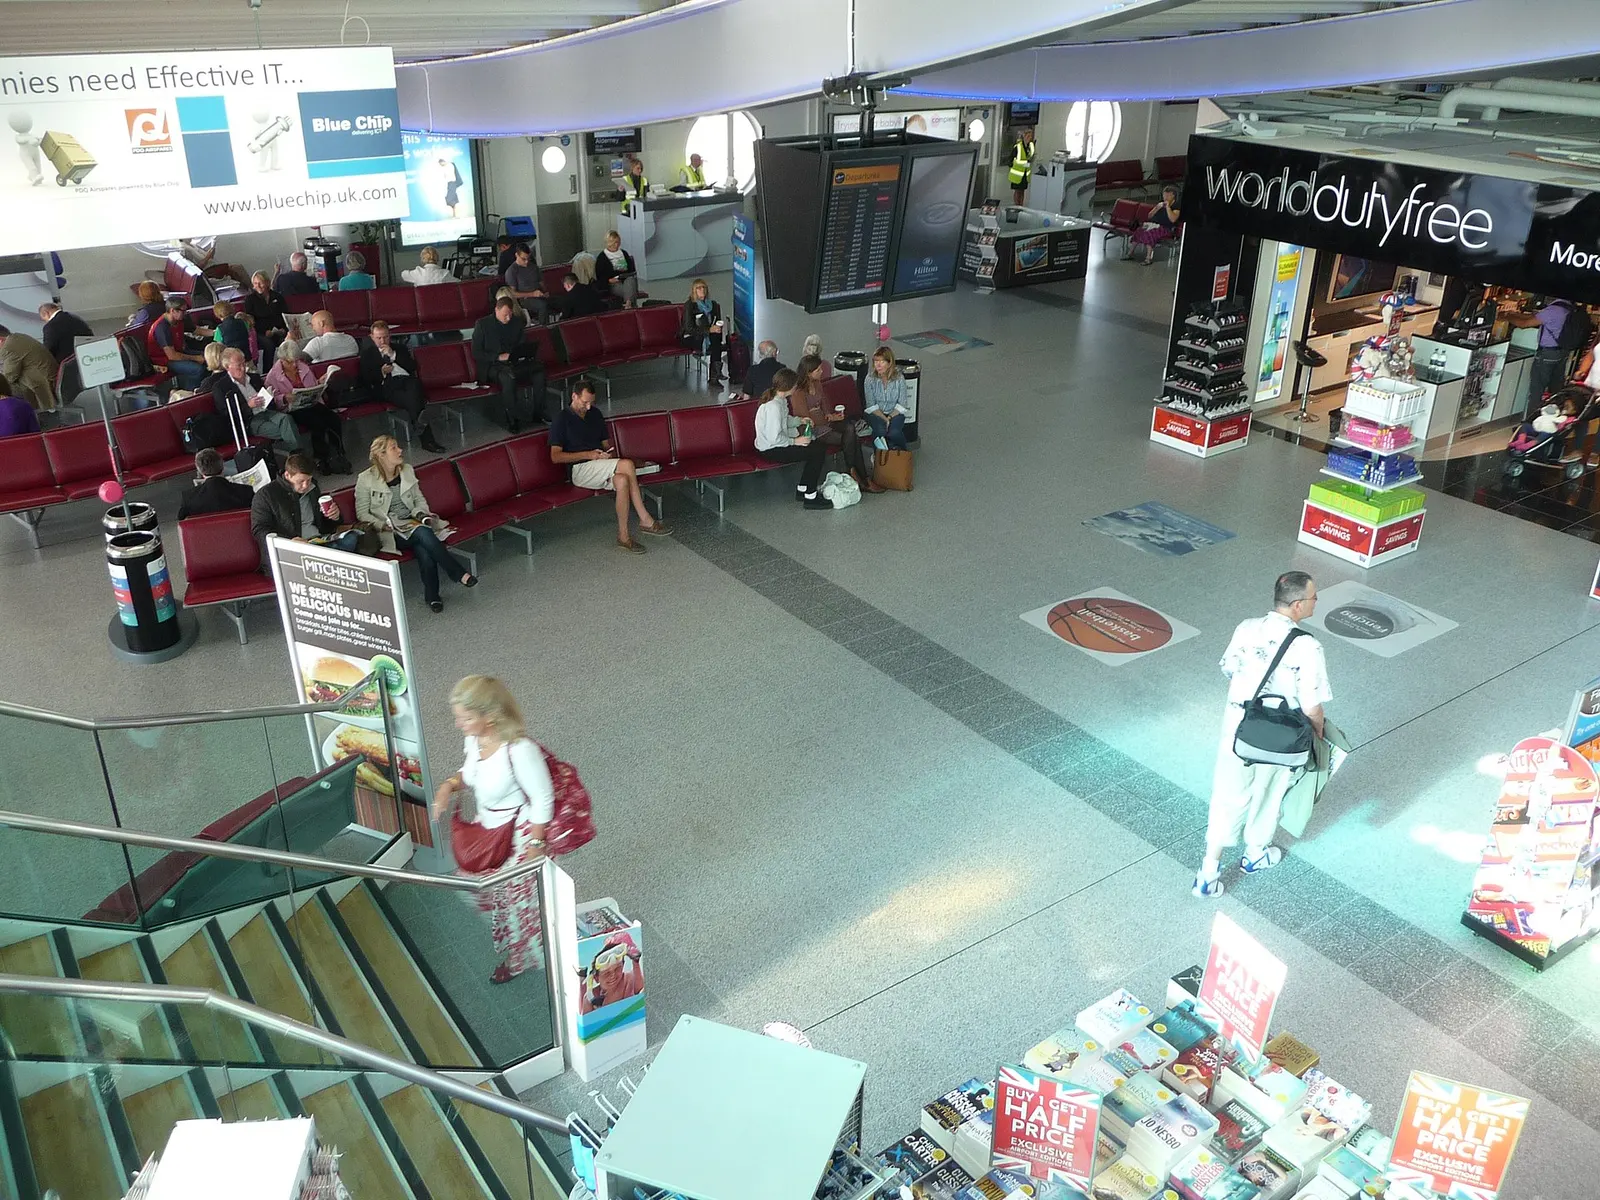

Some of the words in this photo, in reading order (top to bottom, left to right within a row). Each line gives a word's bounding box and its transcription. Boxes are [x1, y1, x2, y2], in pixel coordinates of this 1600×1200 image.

[1, 71, 60, 95] nies
[68, 67, 137, 92] need
[146, 64, 254, 89] Effective
[263, 63, 304, 85] IT...
[312, 117, 351, 132] Blue
[355, 115, 392, 131] Chip
[203, 185, 397, 215] www.bluechip.uk.com
[1206, 164, 1493, 248] worlddutyfree
[914, 265, 938, 275] Hilton
[1166, 423, 1191, 436] SAVINGS
[1320, 524, 1351, 541] SAVINGS
[1385, 531, 1408, 545] SAVINGS
[305, 560, 364, 583] MITCHELL'S
[289, 582, 308, 595] WE
[308, 586, 343, 604] SERVE
[292, 594, 351, 618] DELICIOUS
[353, 608, 391, 628] MEALS
[1076, 608, 1141, 641] basketball
[1340, 609, 1389, 634] Fencing
[1216, 971, 1261, 1019] PRICE
[944, 1092, 974, 1121] BENNET
[951, 1089, 981, 1117] MICHAE
[1005, 1097, 1086, 1134] HALF
[1006, 1086, 1034, 1102] BUY
[1039, 1096, 1044, 1105] 1
[1049, 1099, 1077, 1114] GET
[1081, 1108, 1087, 1118] 1
[1418, 1096, 1451, 1114] BUY
[1466, 1110, 1500, 1126] GET
[1141, 1116, 1152, 1128] JO
[1228, 1101, 1262, 1132] Montanari
[1412, 1107, 1507, 1146] HALF
[918, 1136, 935, 1153] CHRI
[1011, 1118, 1075, 1149] PRICE
[1417, 1129, 1491, 1162] PRICE
[904, 1135, 939, 1168] CARTER
[1011, 1137, 1073, 1161] EXCLUSIVE
[1039, 1153, 1072, 1167] EDITIONS
[1413, 1148, 1485, 1175] EXCLUSIVE
[952, 1168, 971, 1185] CLIV
[980, 1179, 1006, 1200] PRIV
[993, 1169, 1018, 1191] PATTER
[1004, 1172, 1021, 1187] JAME
[1192, 1161, 1225, 1191] BUSTERS
